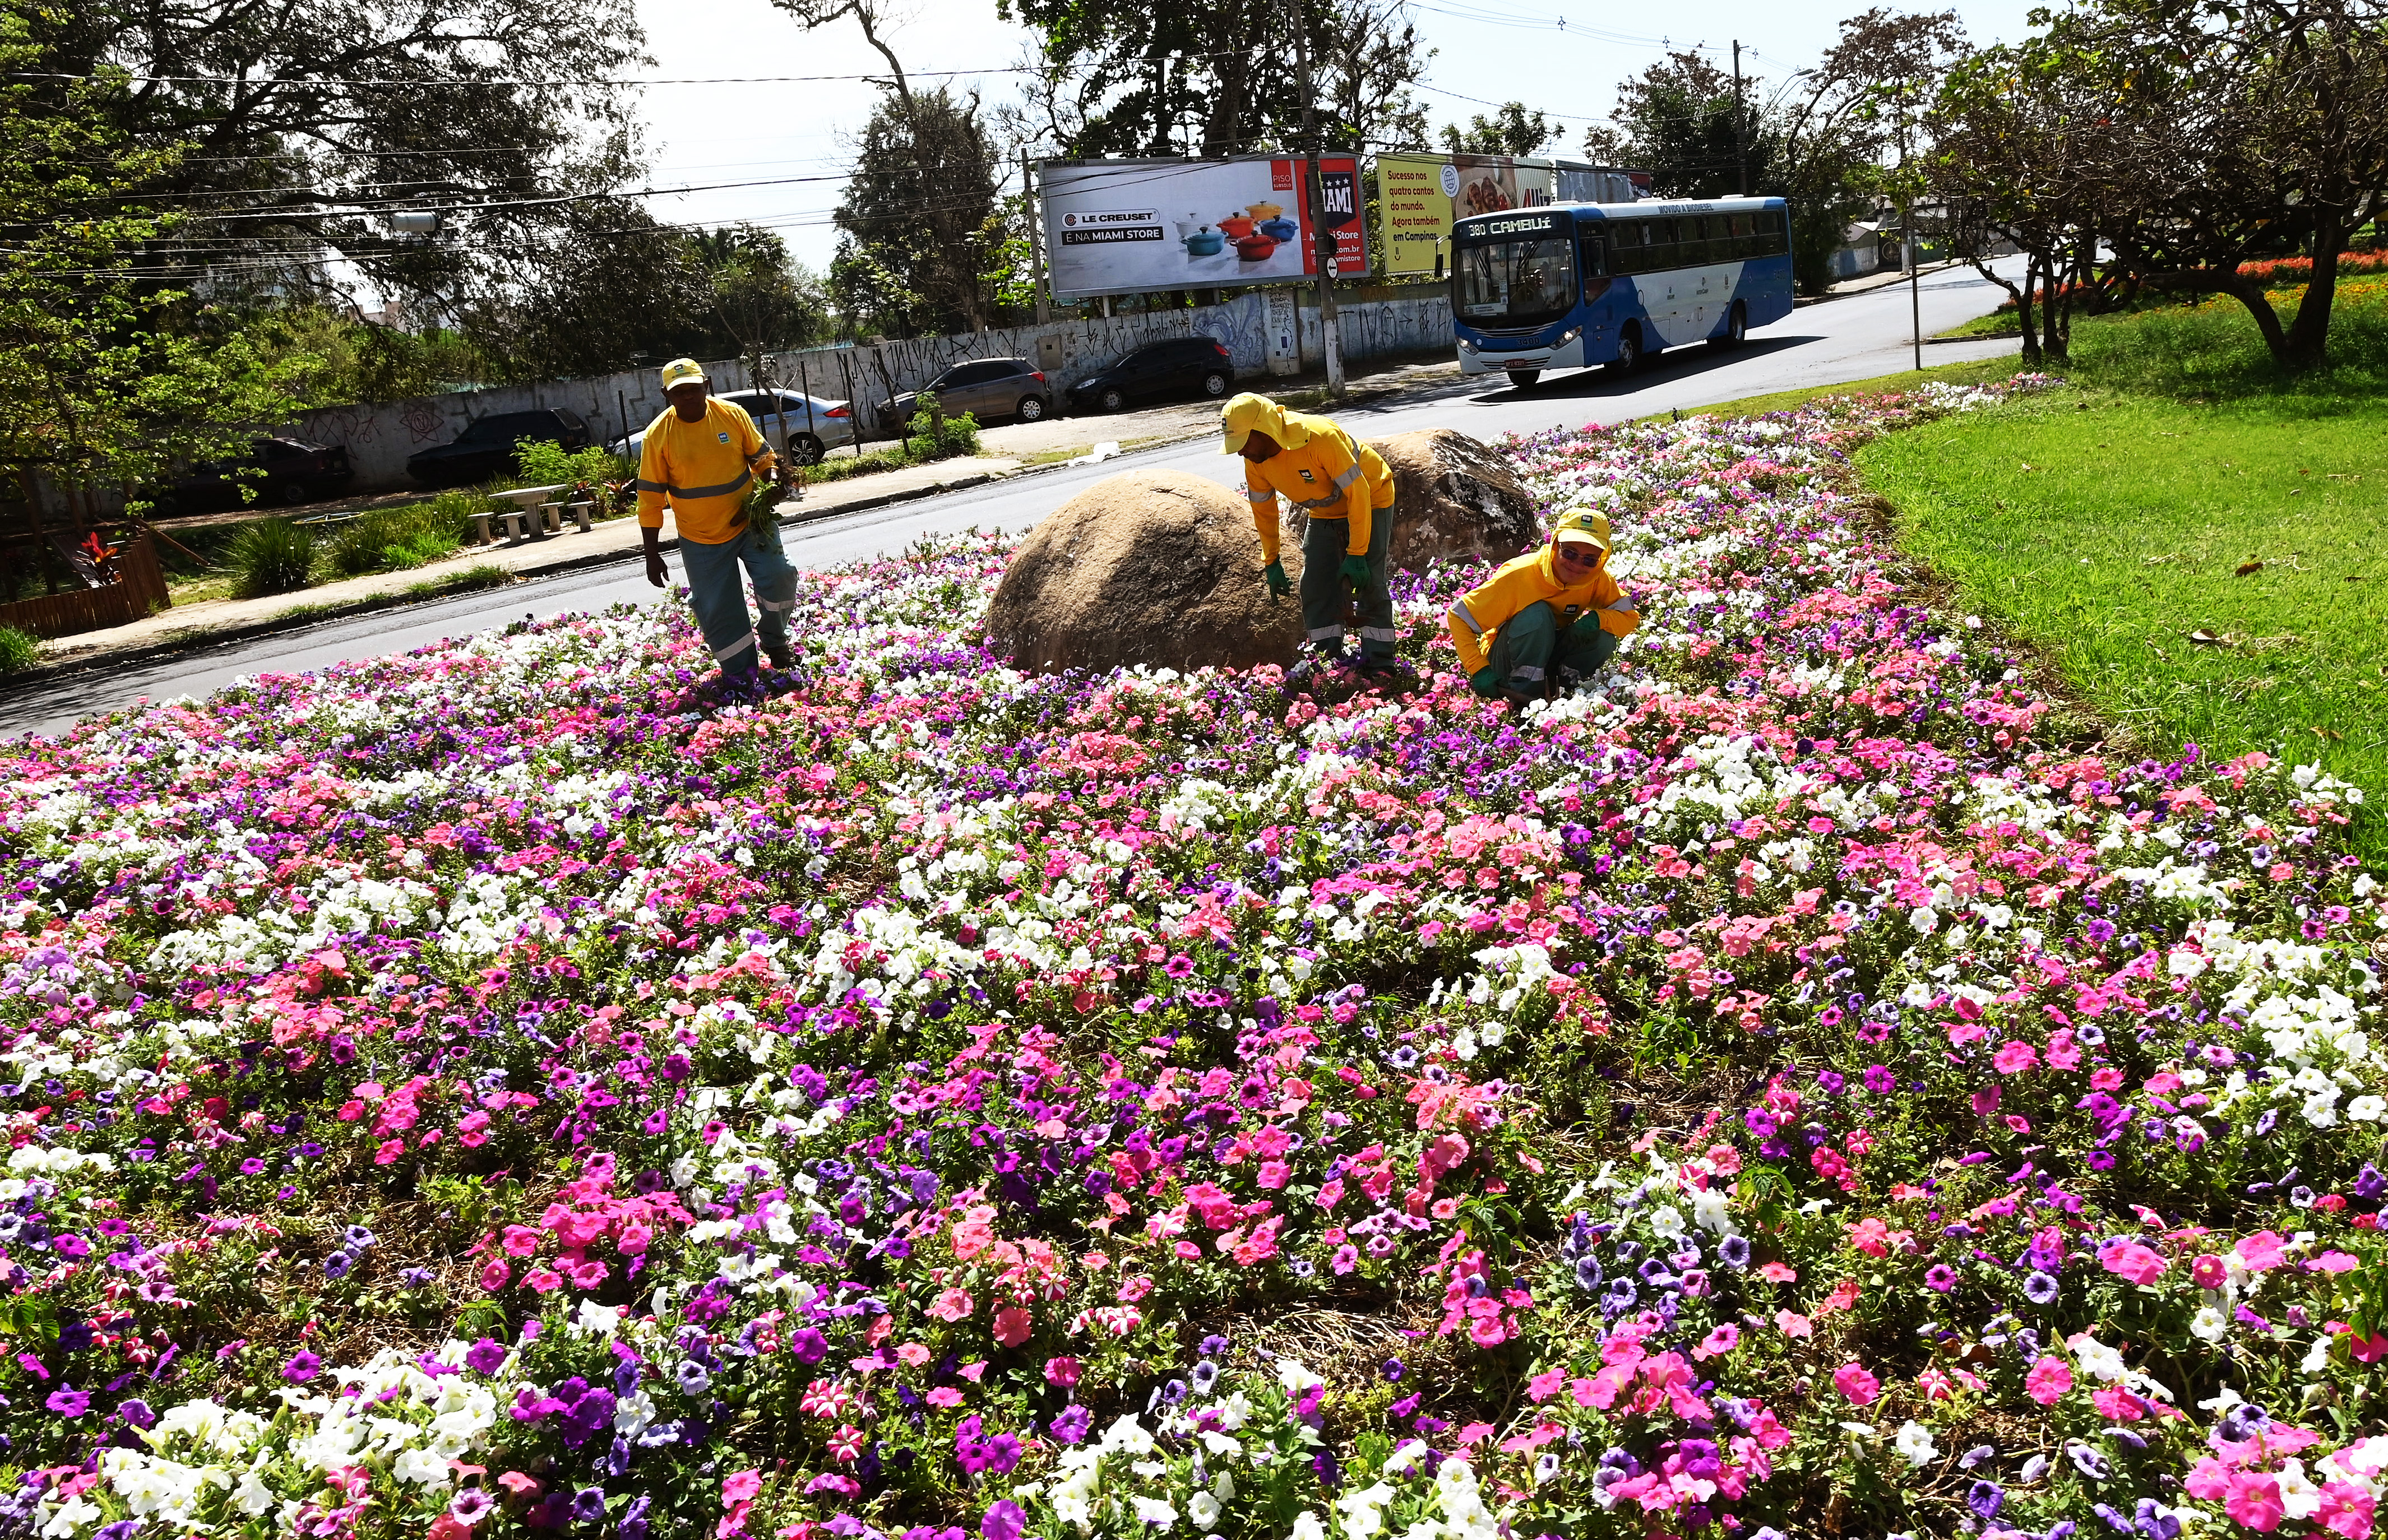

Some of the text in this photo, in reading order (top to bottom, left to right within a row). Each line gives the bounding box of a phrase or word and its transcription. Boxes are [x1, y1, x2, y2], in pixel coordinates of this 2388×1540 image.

[1272, 174, 1291, 183] PISO
[1387, 170, 1414, 180] Sucesso
[1389, 186, 1434, 198] quatro cantos
[1322, 186, 1353, 214] IAMI
[1391, 200, 1426, 211] do mundo.
[1658, 203, 1714, 214] MOVIDO A BIODIESEL
[1099, 212, 1153, 222] CREUSET
[1392, 215, 1440, 228] Agora também
[1336, 230, 1359, 240] Store
[1468, 224, 1486, 236] 380
[1066, 229, 1160, 243] É NA MIAMI STORE
[1393, 233, 1404, 242] em
[1517, 337, 1540, 346] 3400
